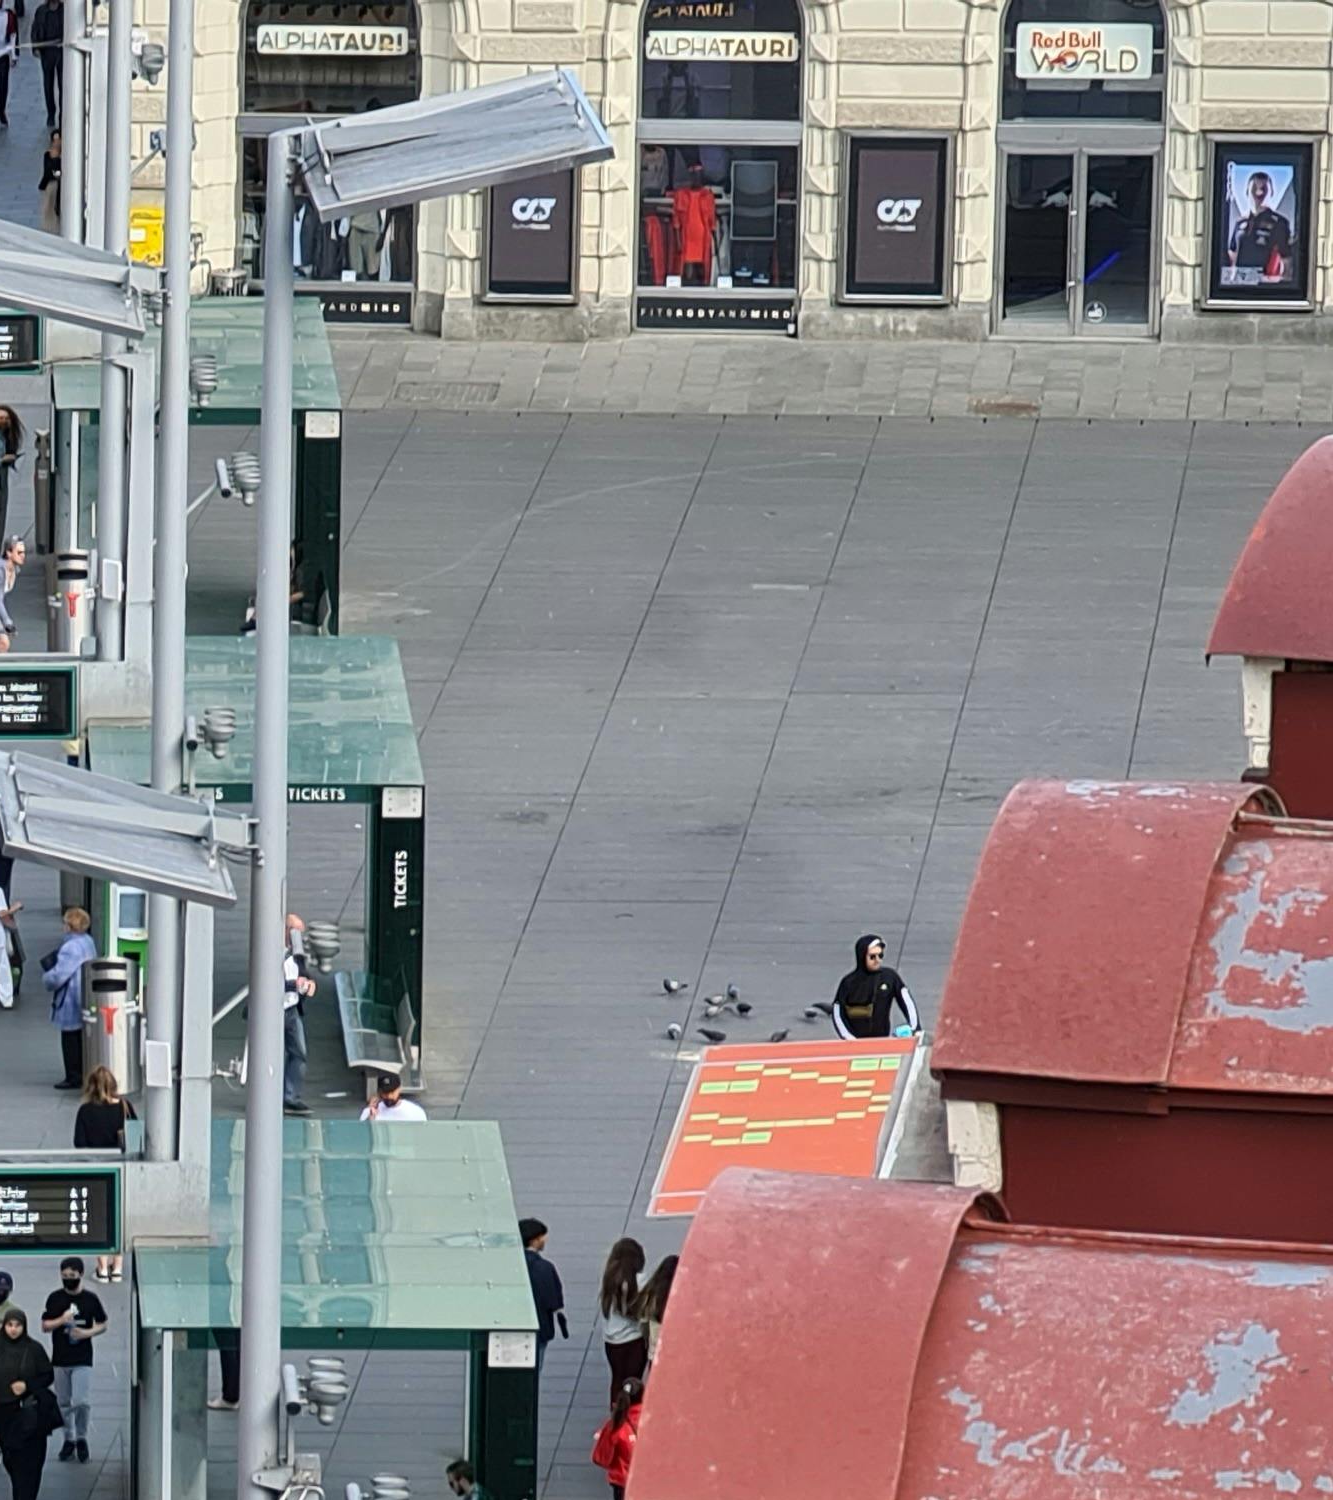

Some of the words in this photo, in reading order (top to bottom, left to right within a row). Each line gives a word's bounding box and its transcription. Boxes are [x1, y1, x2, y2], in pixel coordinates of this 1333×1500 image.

[260, 31, 403, 51] ALPHATAURI
[649, 36, 794, 57] ALPHATAURI
[1032, 31, 1066, 48] Red
[1069, 31, 1101, 48] Bull
[1030, 48, 1139, 73] WORLD
[288, 788, 346, 801] TICKETS
[393, 850, 408, 908] TICKETS
